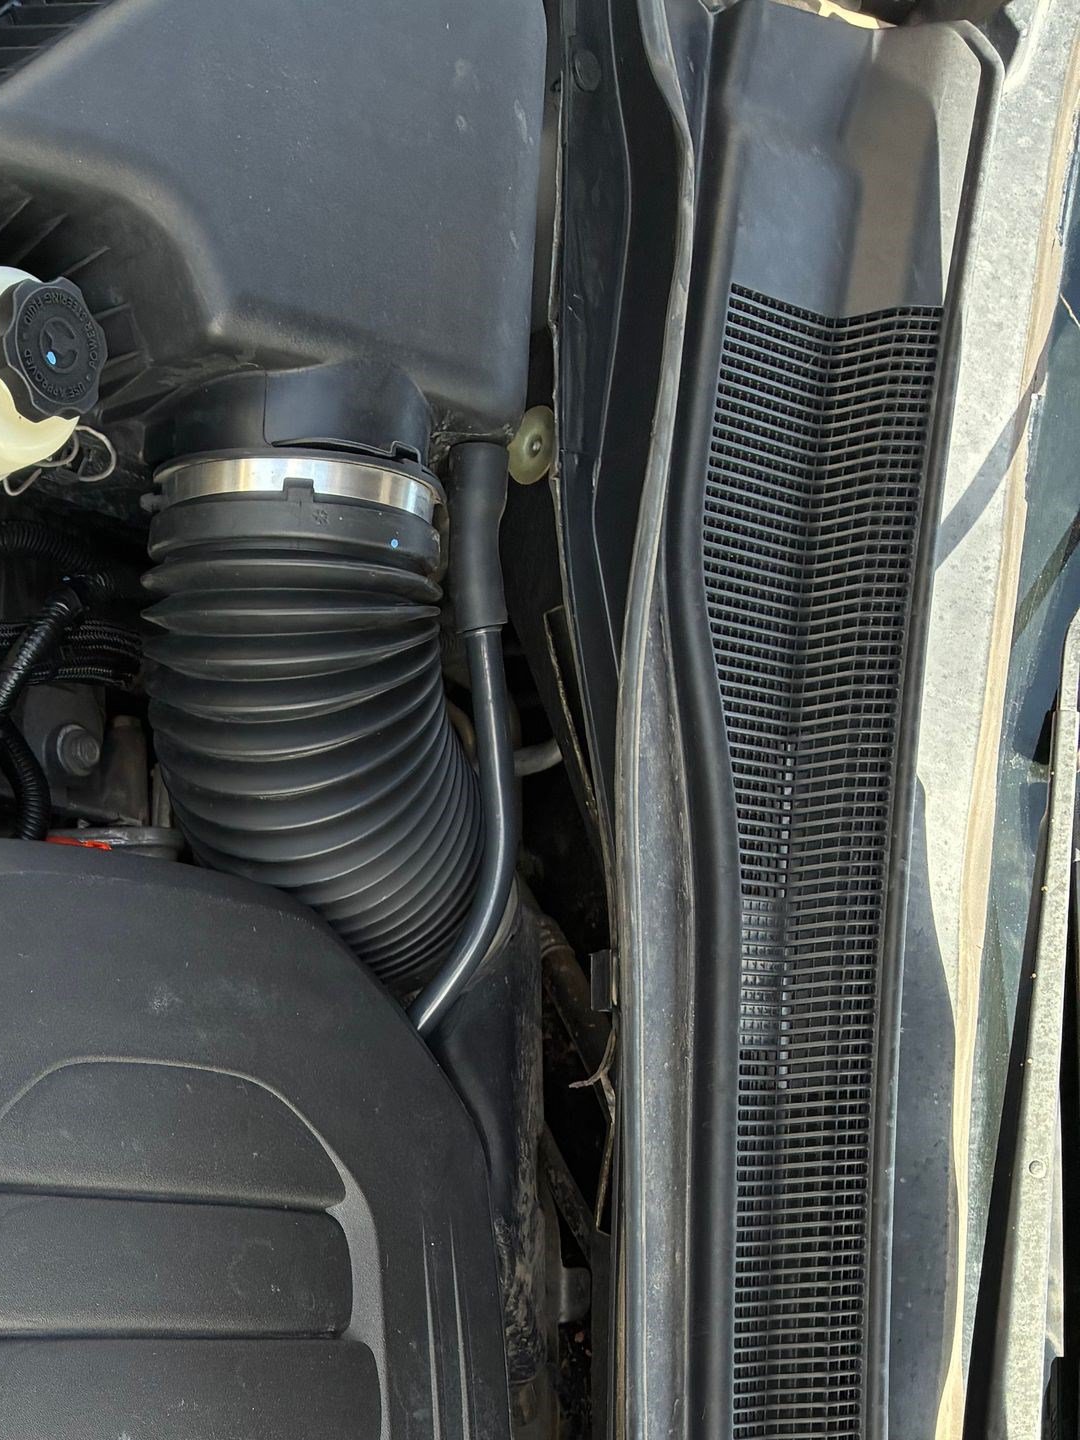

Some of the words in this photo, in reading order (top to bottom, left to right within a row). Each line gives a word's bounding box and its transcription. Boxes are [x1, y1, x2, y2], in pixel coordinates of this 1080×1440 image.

[24, 297, 44, 325] FLUID
[45, 291, 87, 322] STEERING
[86, 321, 97, 369] POWER
[24, 348, 64, 397] APPROVED
[67, 382, 86, 398] USE
